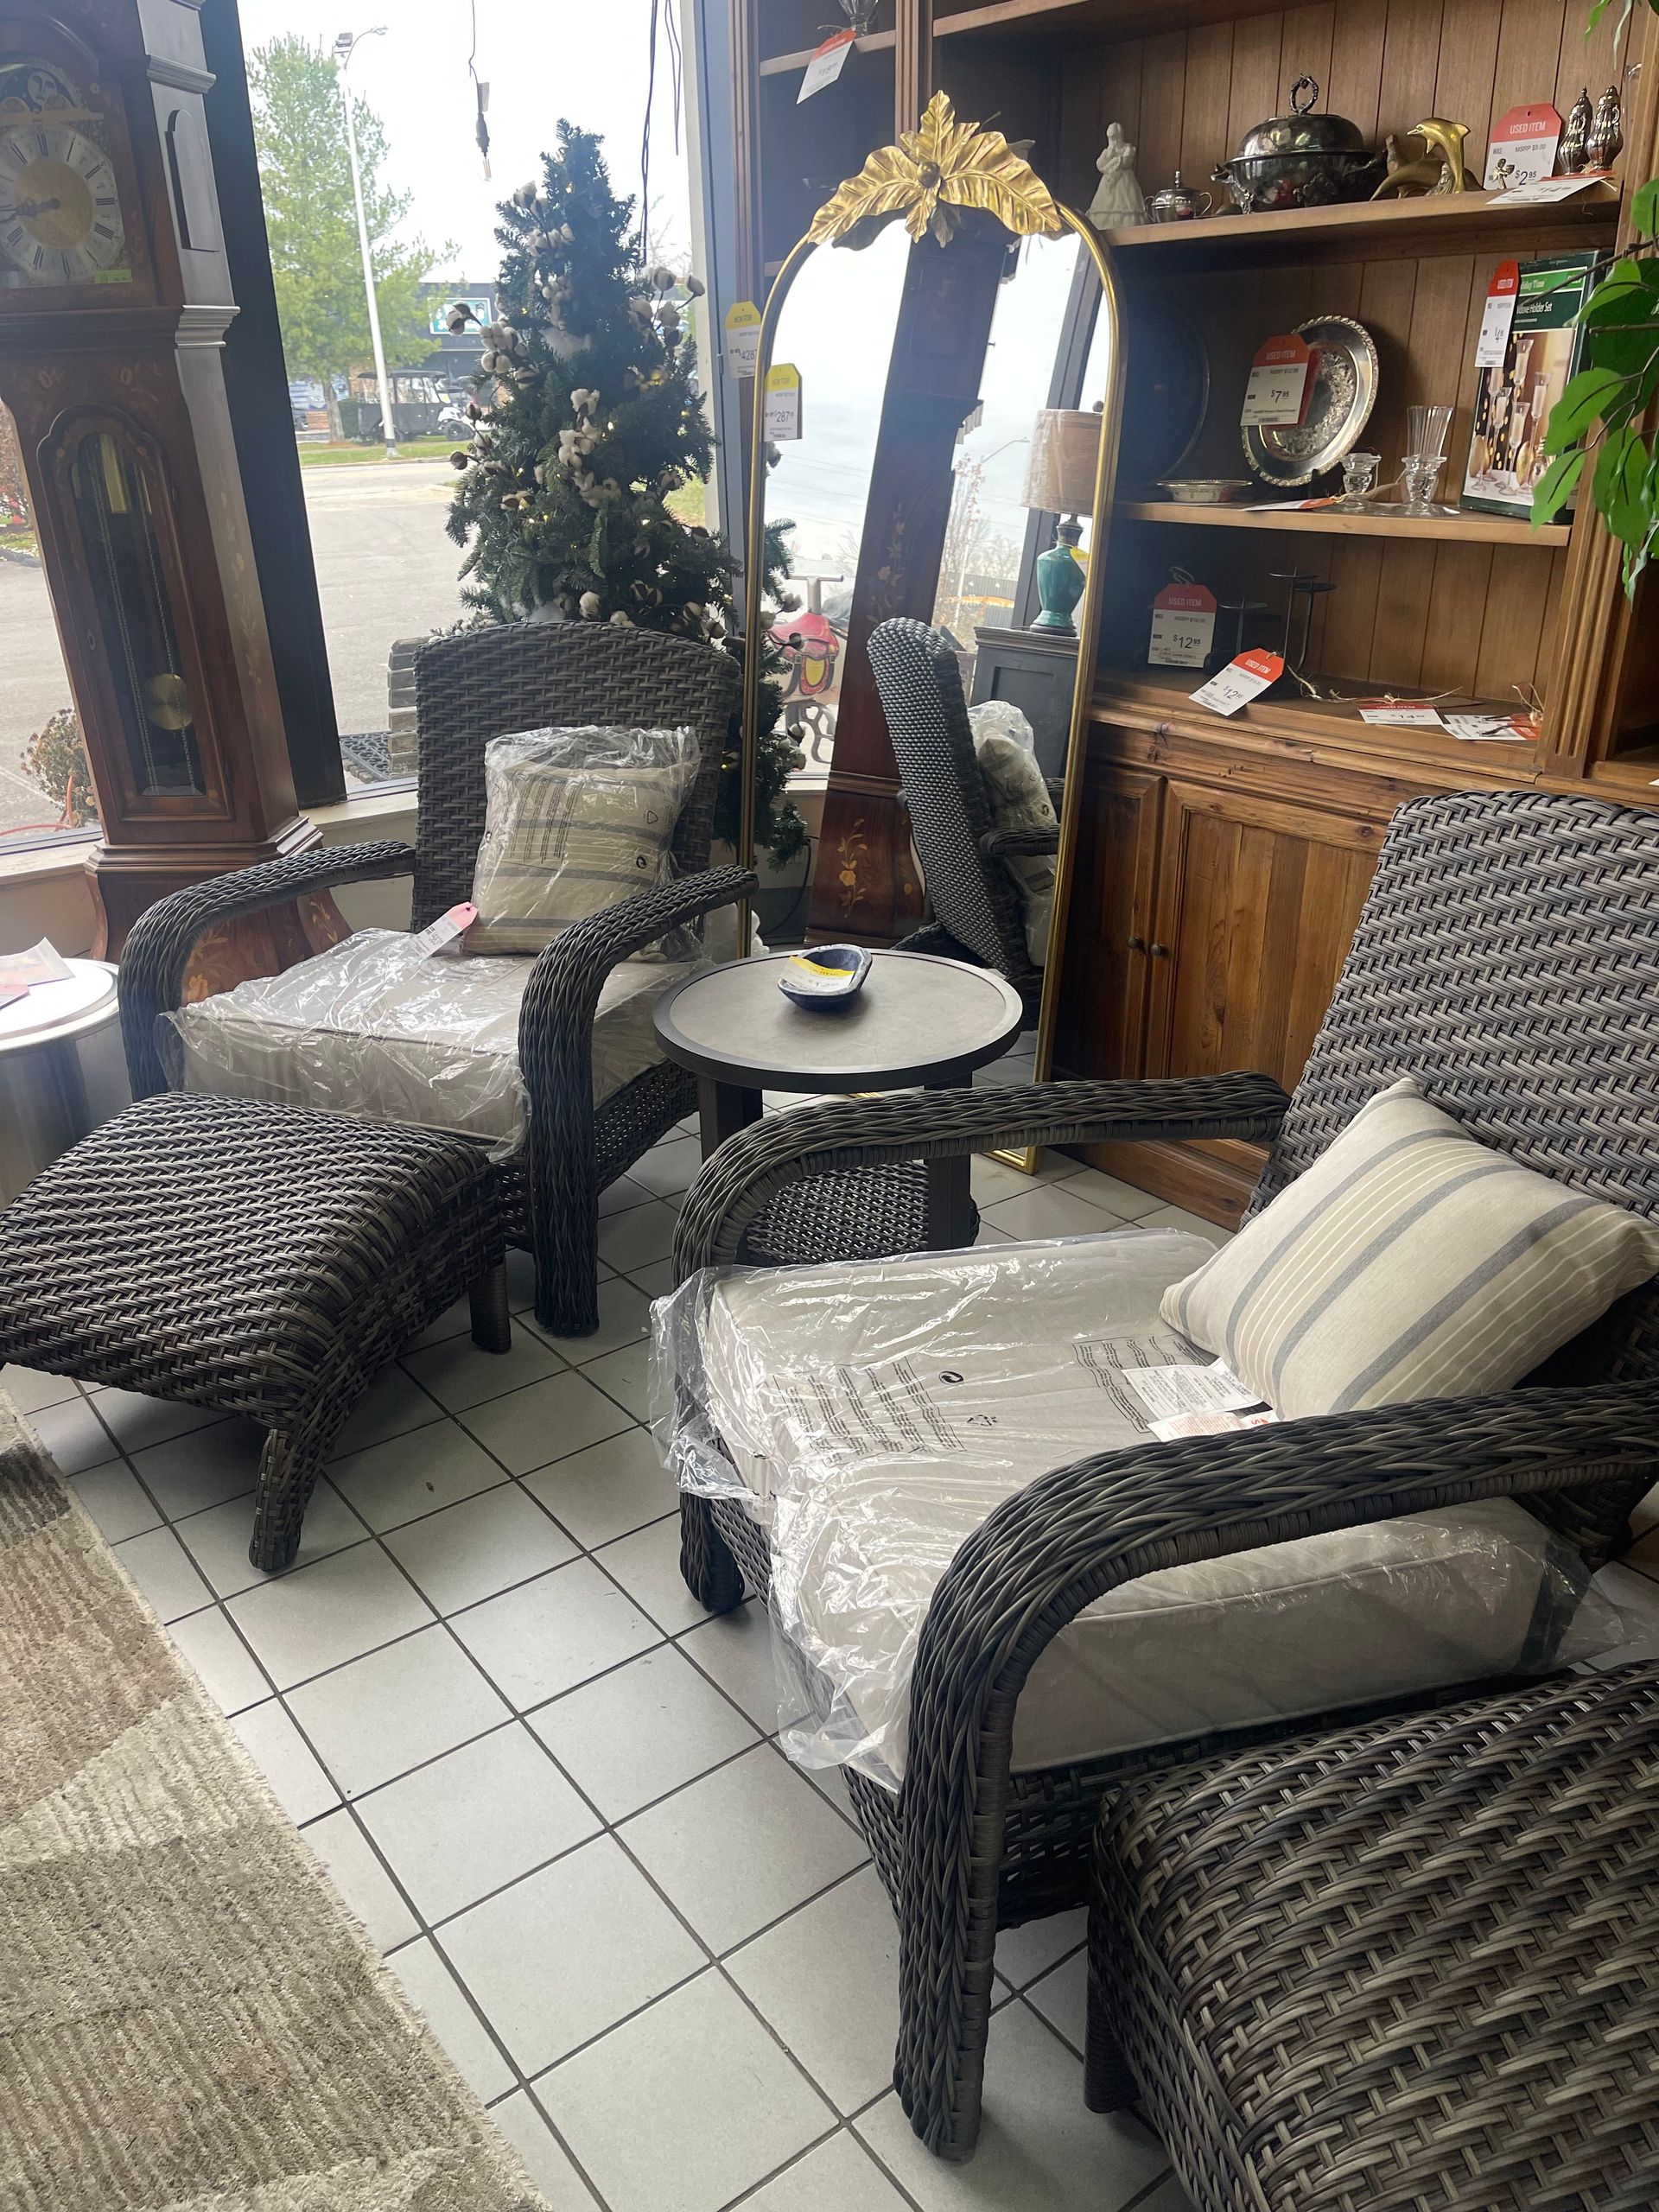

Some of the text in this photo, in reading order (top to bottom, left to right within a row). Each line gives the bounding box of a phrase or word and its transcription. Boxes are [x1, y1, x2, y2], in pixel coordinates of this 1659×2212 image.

[1510, 121, 1546, 135] USED ITEM
[1544, 301, 1553, 312] Set
[1266, 350, 1296, 360] USED ITEM
[1168, 597, 1185, 606] USED
[1245, 659, 1272, 674] USED ITEM
